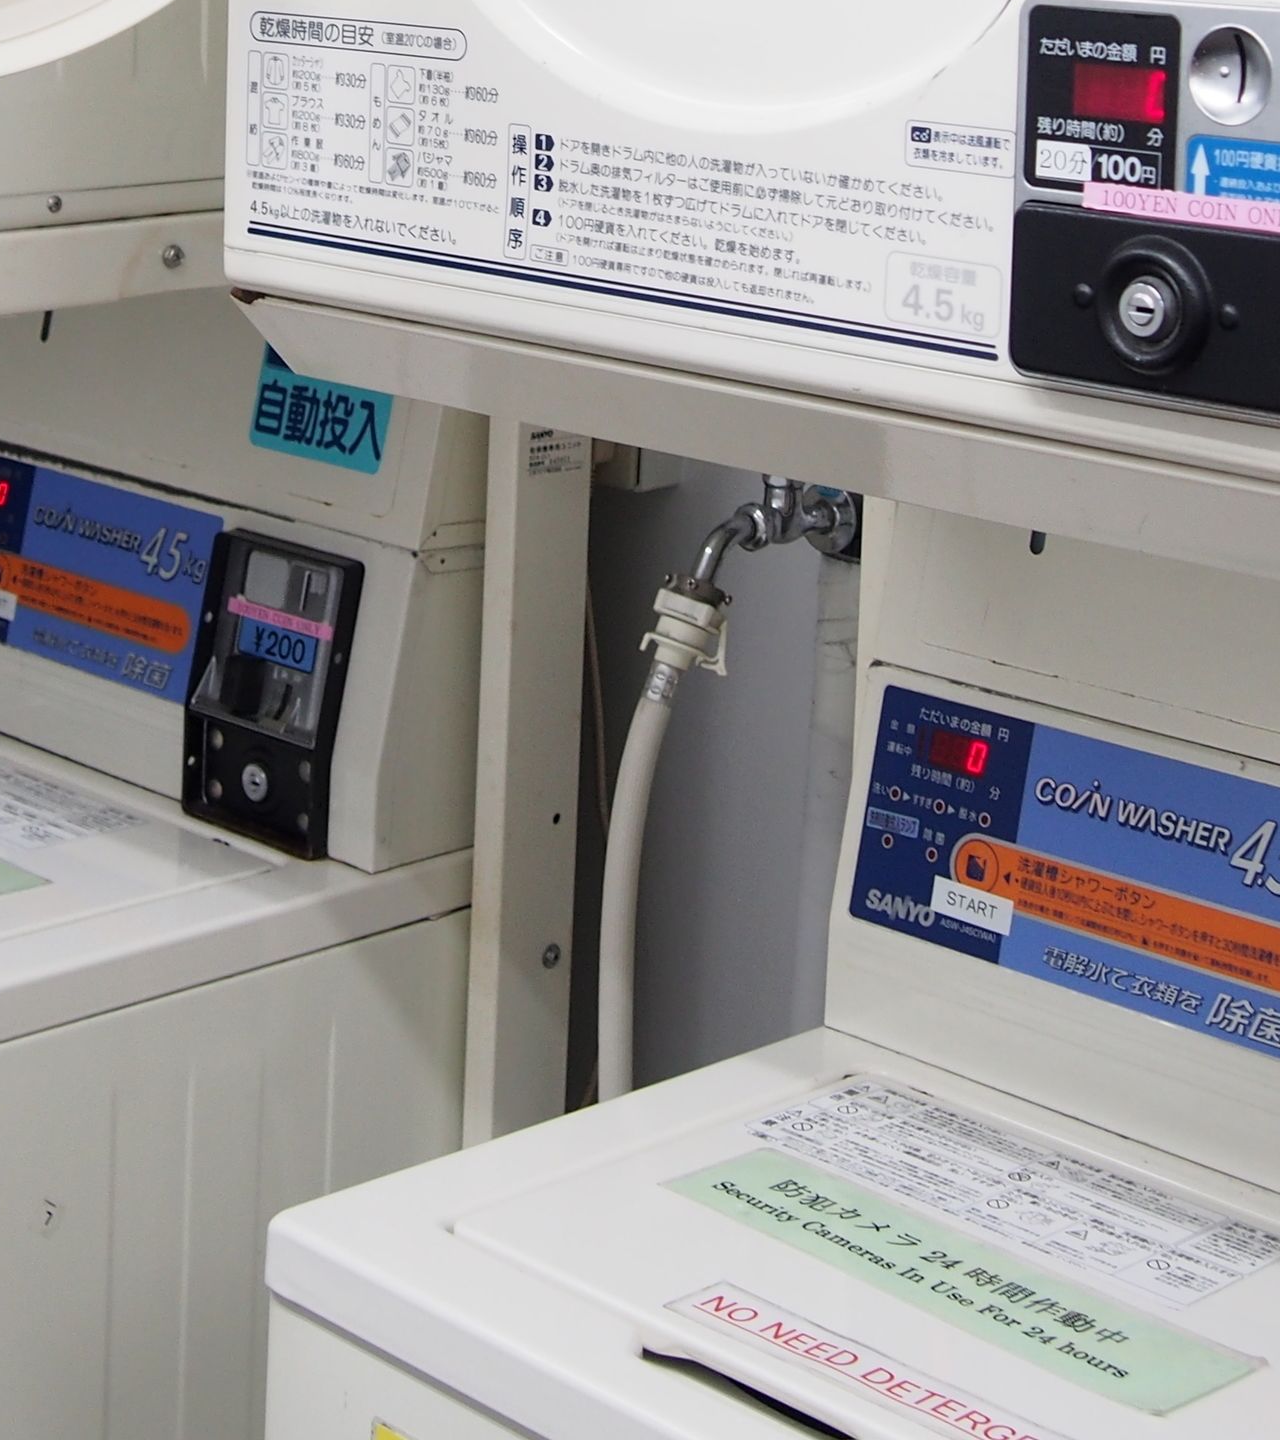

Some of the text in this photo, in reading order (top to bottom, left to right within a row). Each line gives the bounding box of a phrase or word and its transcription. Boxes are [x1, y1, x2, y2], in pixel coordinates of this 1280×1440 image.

[259, 16, 374, 47] 乾燥時間の目安
[1039, 37, 1167, 66] ただいまの金額 円
[335, 72, 367, 89] 約30分
[464, 86, 499, 104] 約60分
[334, 112, 366, 130] 約30分
[463, 127, 498, 146] 約60分
[1146, 127, 1165, 148] 分
[333, 153, 366, 171] 約60分
[463, 170, 498, 189] 約60分
[507, 133, 528, 251] 操作順序
[1102, 189, 1177, 215] 100YEN
[1188, 200, 1237, 221] COIN
[254, 379, 382, 461] 自動投入
[253, 625, 306, 664] ¥200
[920, 708, 1010, 742] ただいまの金額 円
[966, 740, 990, 774] 0
[988, 786, 1001, 800] 分
[1115, 799, 1233, 857] WASHER
[865, 889, 935, 928] SANYO
[946, 890, 998, 920] START
[1042, 945, 1204, 1015] 電解水で衣類を
[712, 1180, 1130, 1379] Security Cameras In Use For 24 hours
[699, 1294, 1038, 1440] NO NEED DETERG
